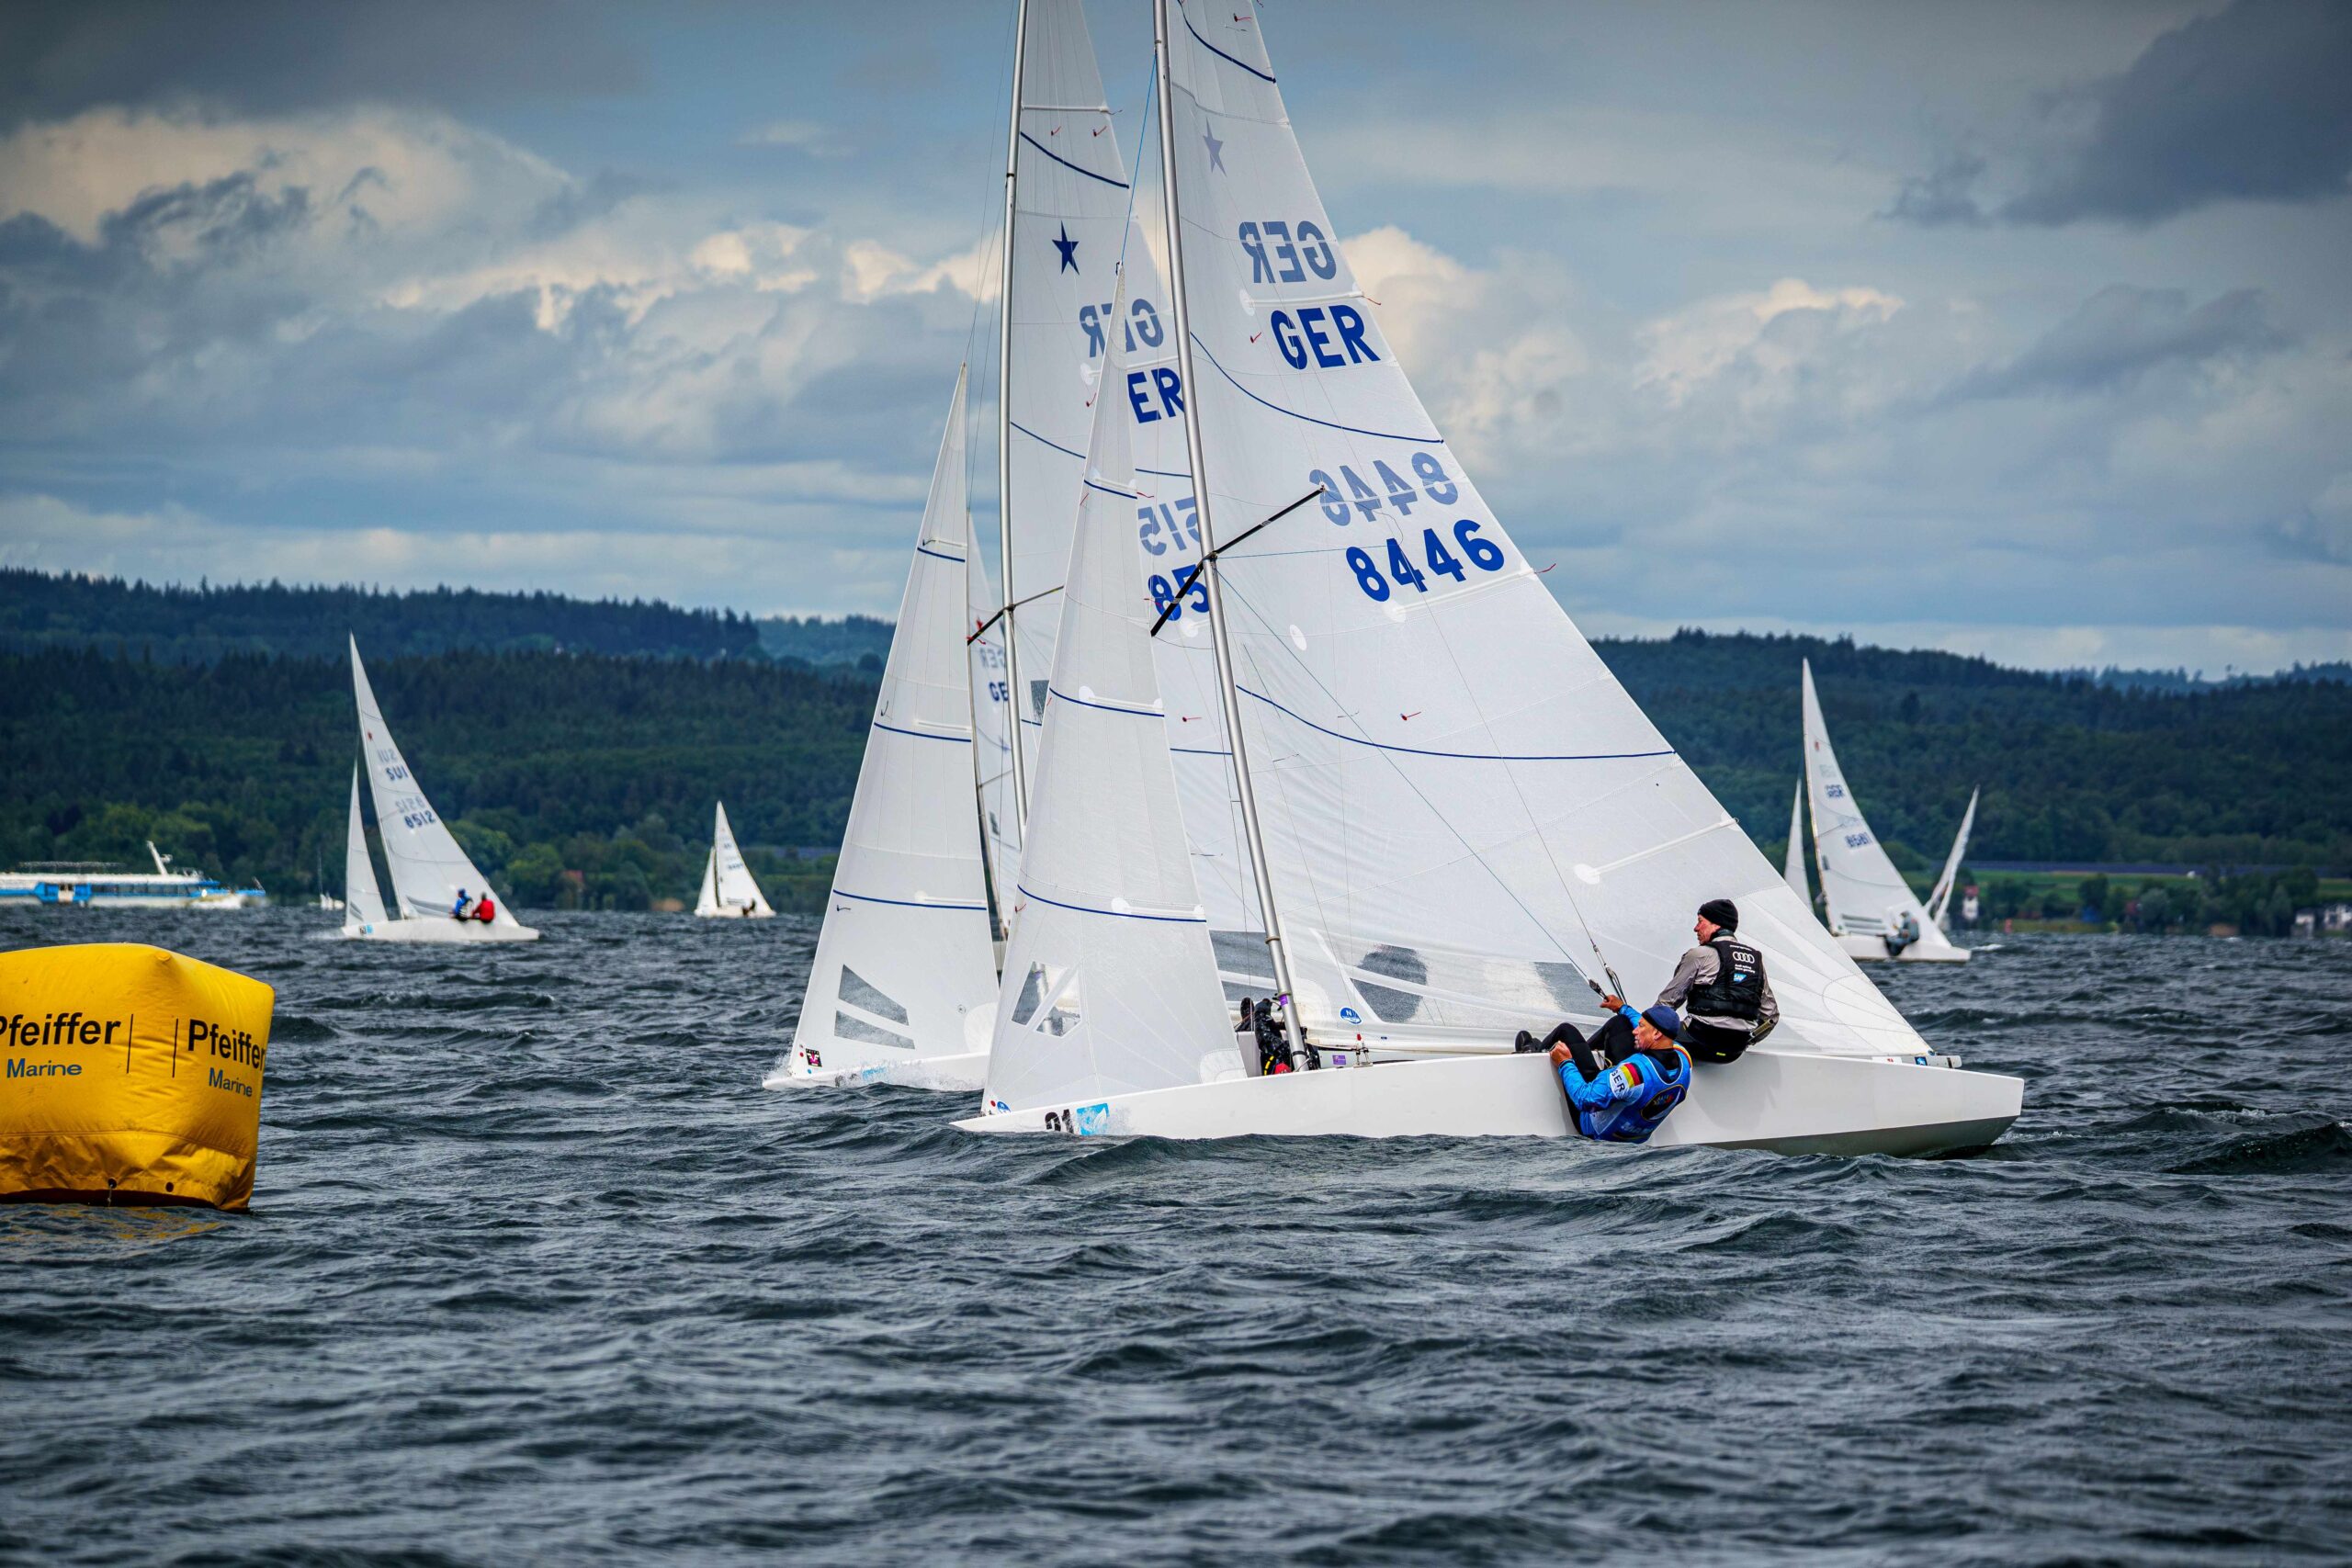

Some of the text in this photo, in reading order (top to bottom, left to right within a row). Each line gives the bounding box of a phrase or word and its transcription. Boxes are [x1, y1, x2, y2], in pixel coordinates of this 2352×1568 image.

[1271, 304, 1381, 370] GER
[1346, 519, 1505, 602] 8446
[386, 765, 409, 781] SUI
[404, 809, 435, 829] 8512
[188, 1019, 266, 1071] Pfeiffer
[6, 1058, 83, 1077] Marine
[209, 1066, 253, 1097] Marine
